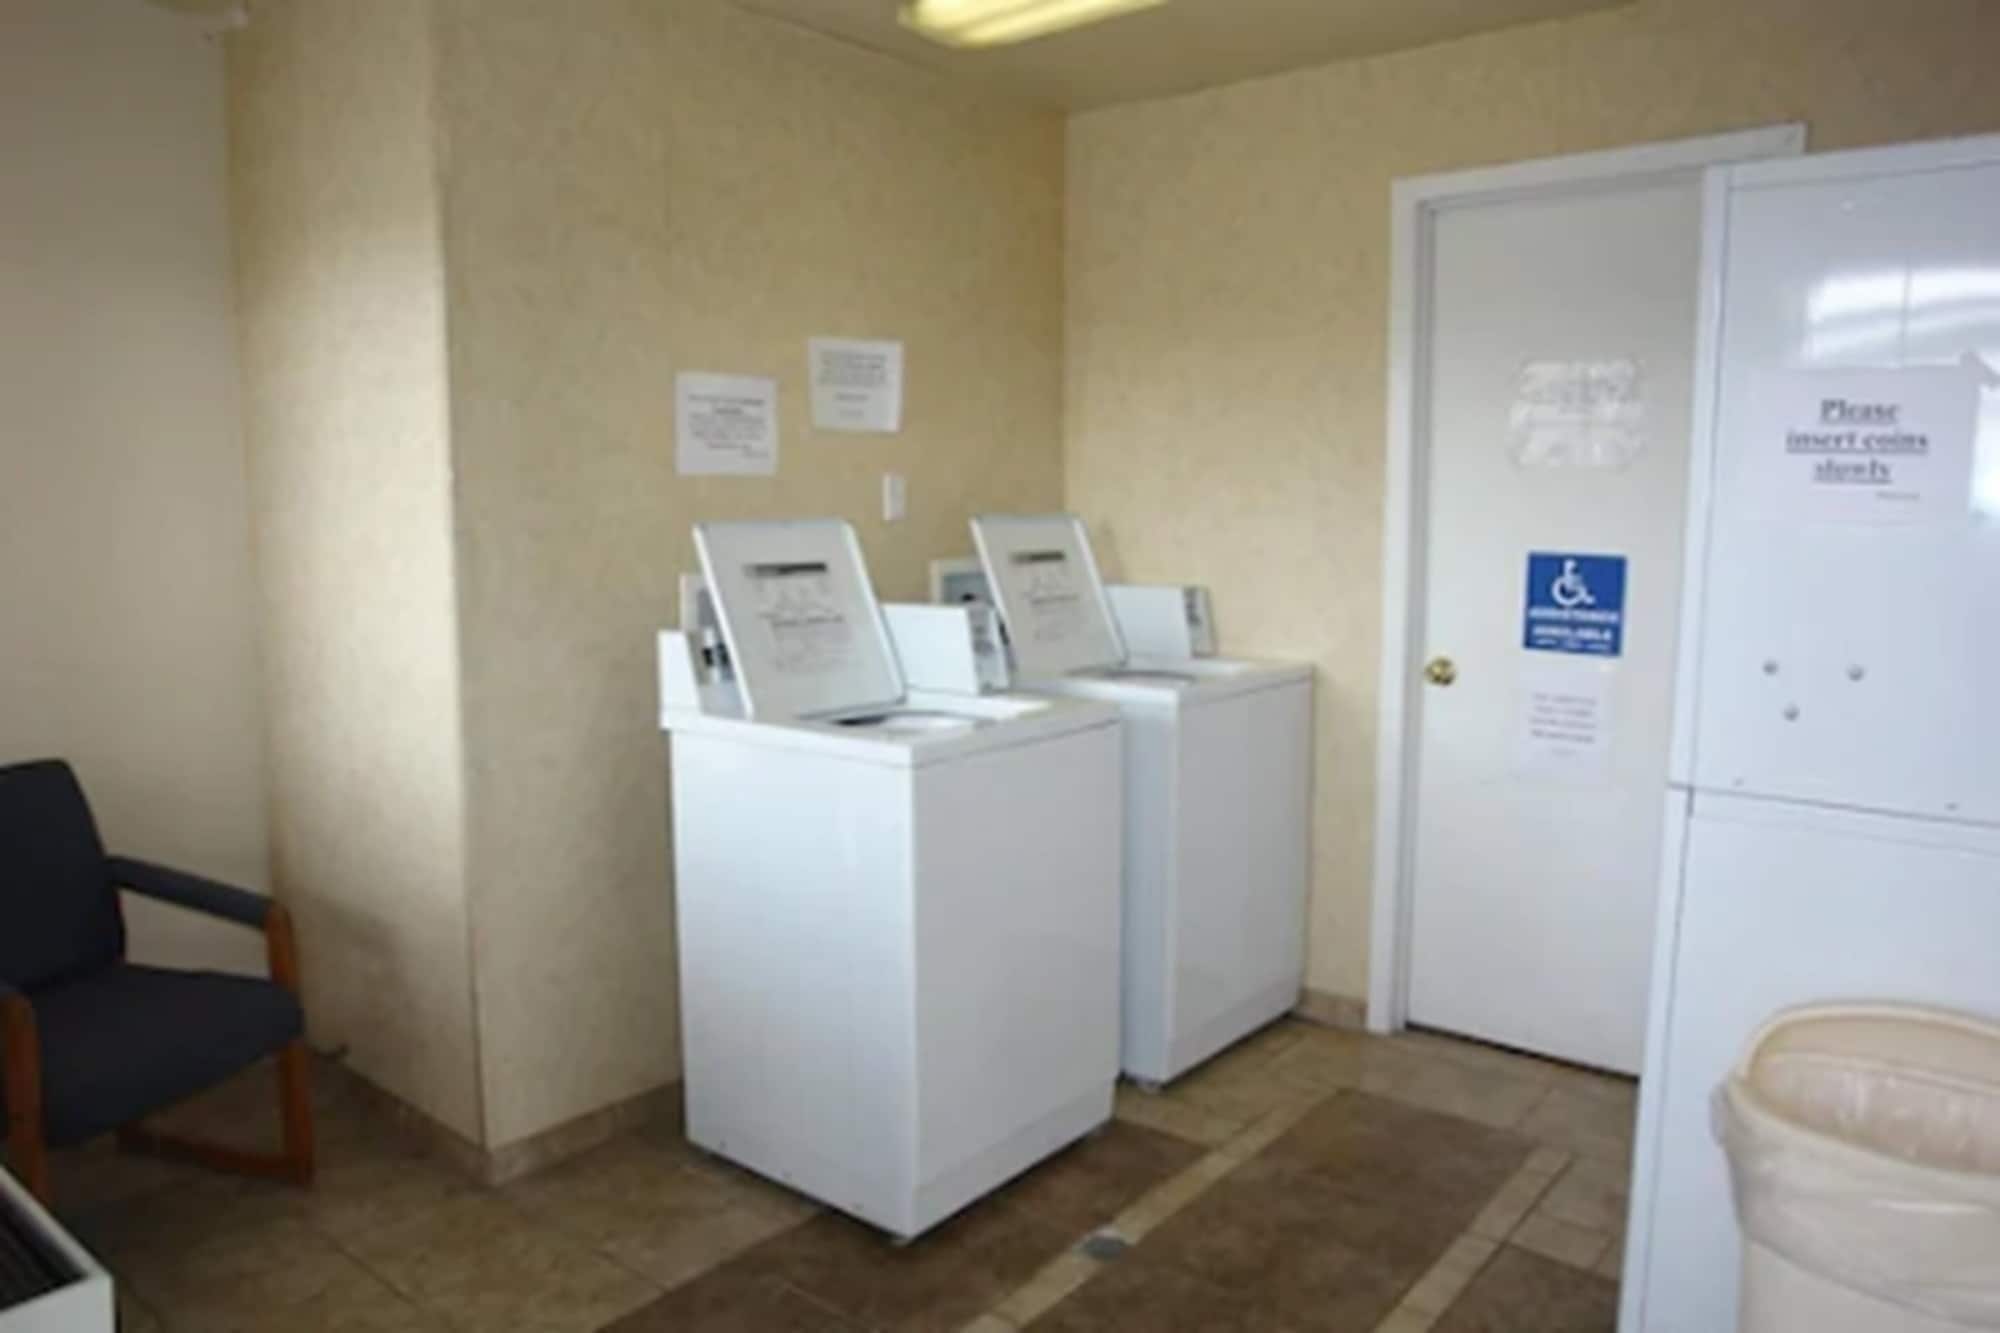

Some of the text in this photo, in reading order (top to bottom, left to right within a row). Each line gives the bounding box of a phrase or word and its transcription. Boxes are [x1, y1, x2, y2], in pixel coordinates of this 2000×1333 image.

[1820, 398, 1900, 424] Please
[1786, 430, 1929, 453] insert coins
[1813, 457, 1891, 484] slowly
